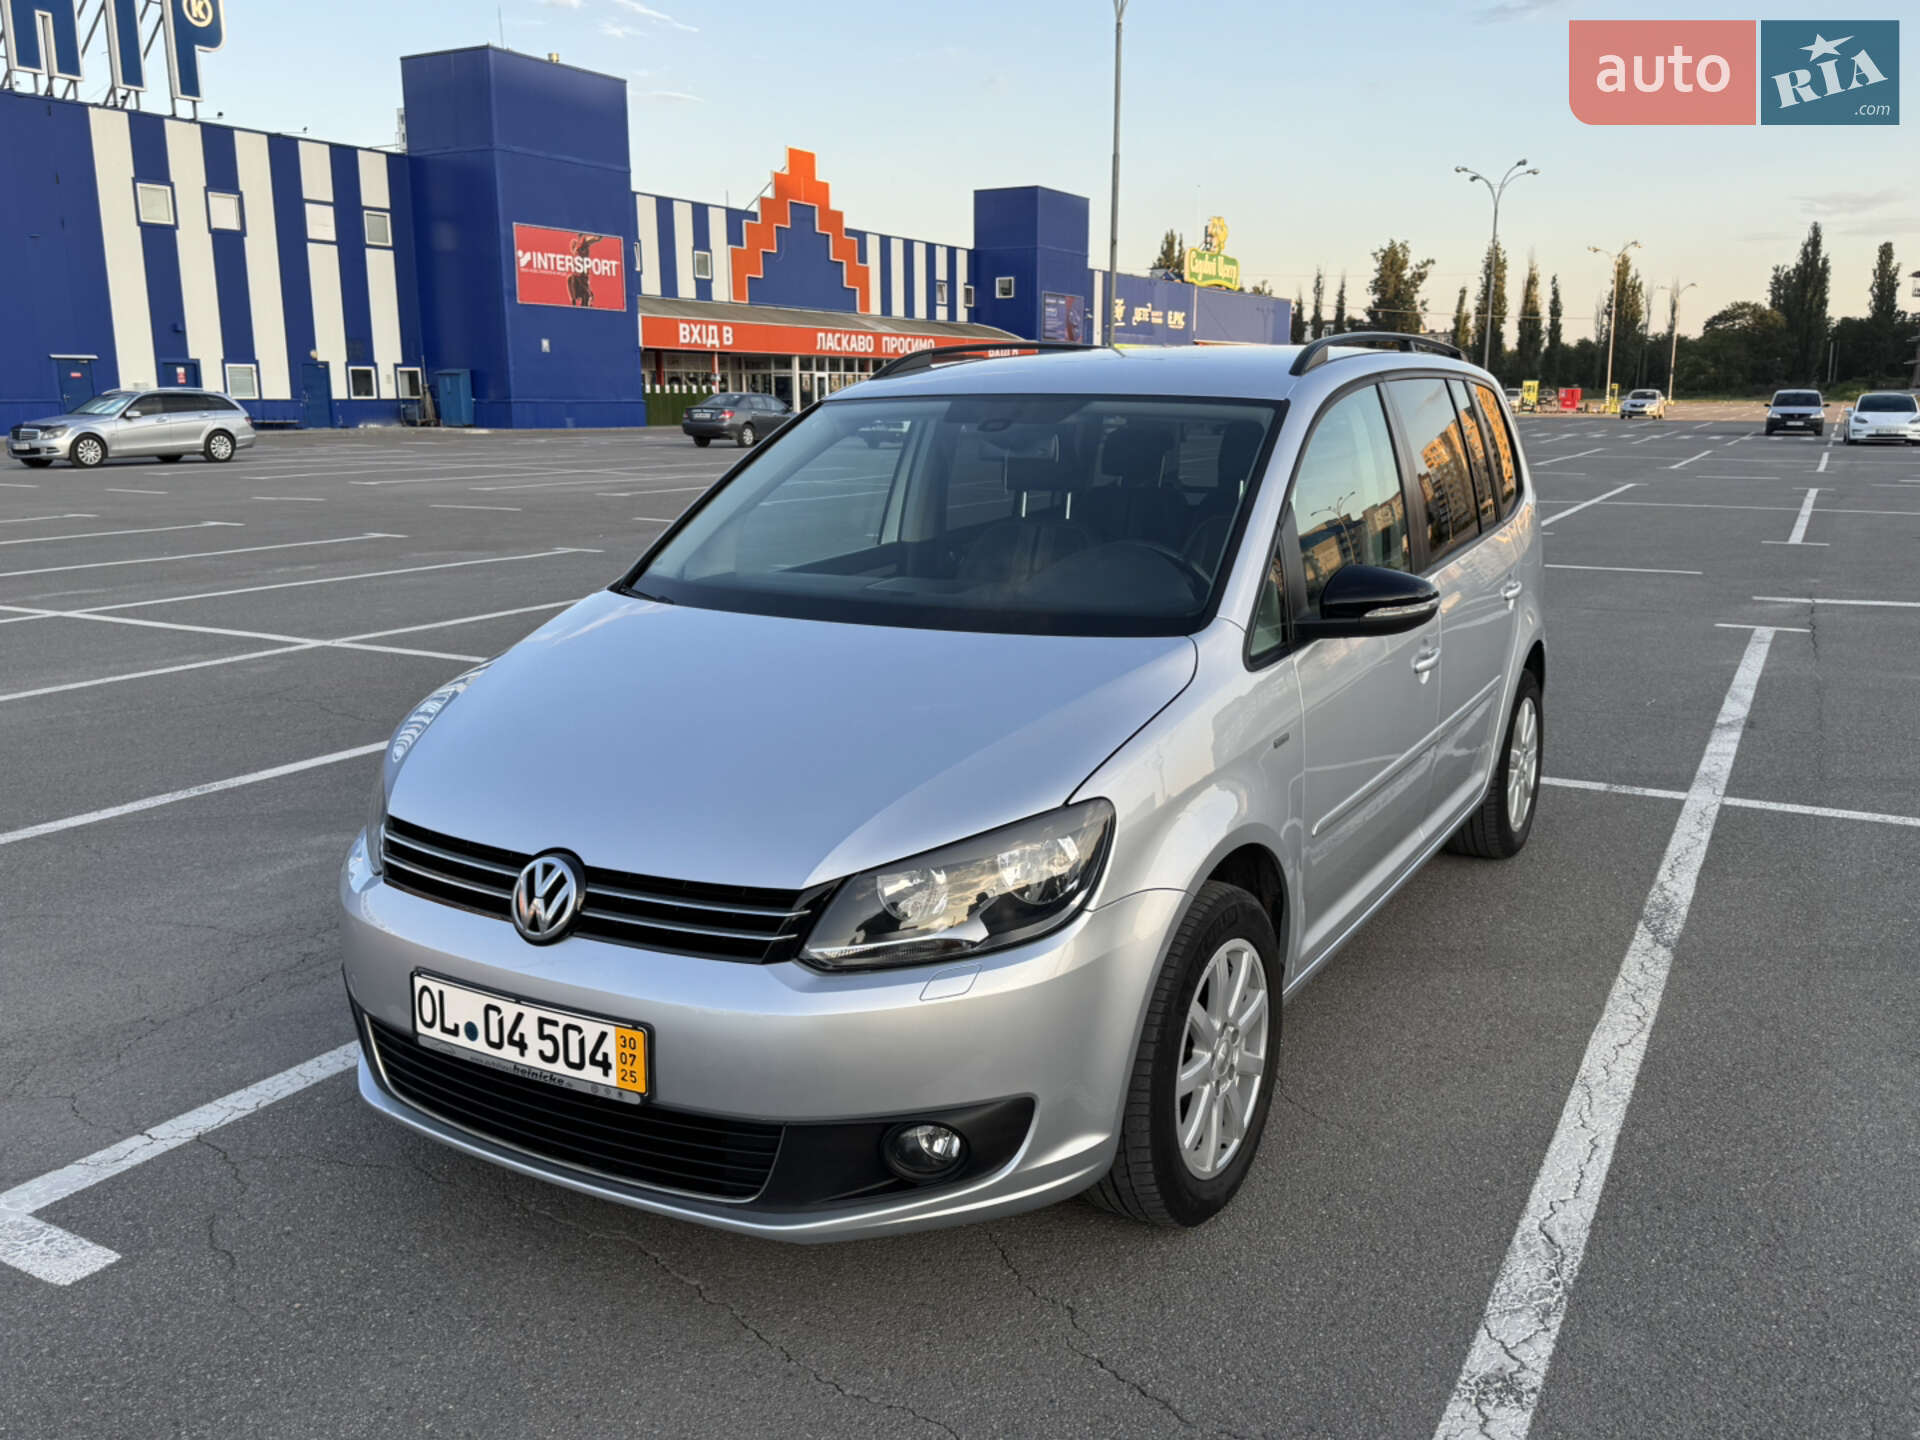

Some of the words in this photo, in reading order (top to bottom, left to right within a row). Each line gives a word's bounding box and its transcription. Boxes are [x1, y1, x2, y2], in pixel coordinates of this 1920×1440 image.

[532, 251, 619, 277] INTERSPORT
[679, 323, 719, 349] ВХІД
[816, 331, 875, 353] ЛАСКАВО
[417, 984, 460, 1038] OL
[619, 1034, 638, 1051] 30
[619, 1052, 637, 1067] 07
[619, 1068, 638, 1084] 25
